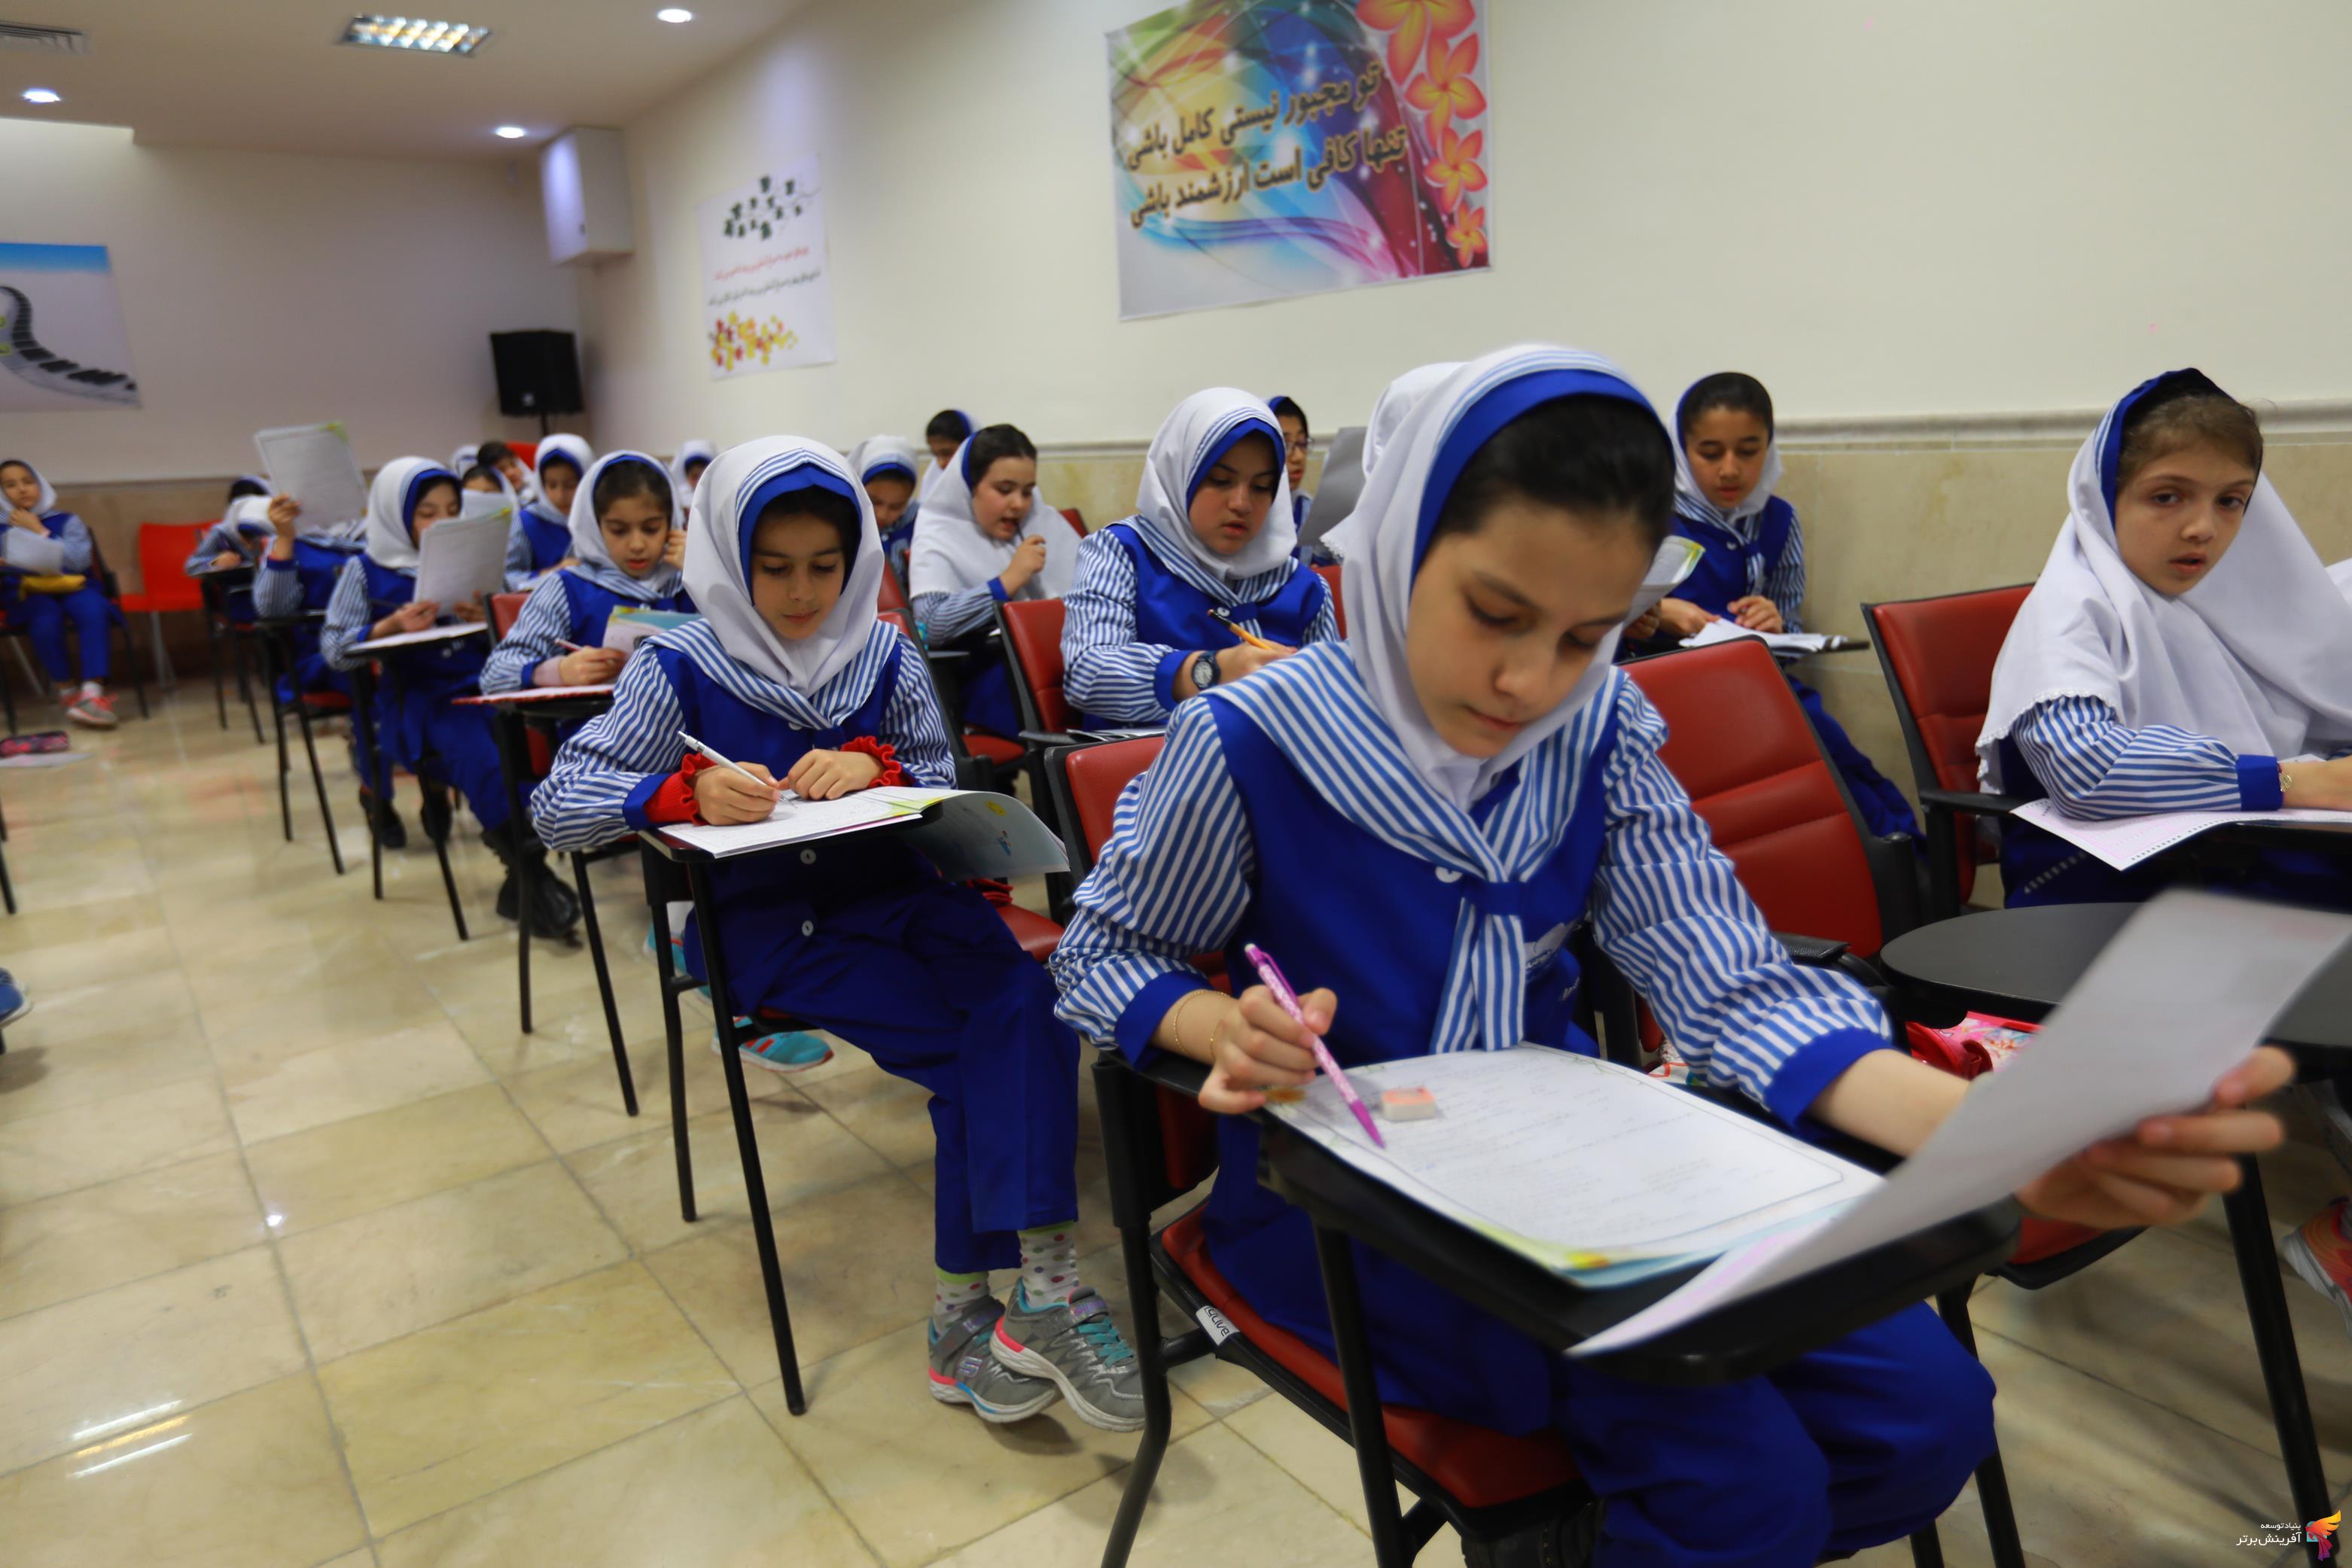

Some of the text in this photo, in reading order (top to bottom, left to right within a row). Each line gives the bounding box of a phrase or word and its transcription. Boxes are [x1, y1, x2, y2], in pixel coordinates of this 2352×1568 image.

[1128, 62, 1383, 171] تو مجبور نیستی کامل باشی
[1132, 124, 1409, 229] تنها کافی است ارزشمند باشی
